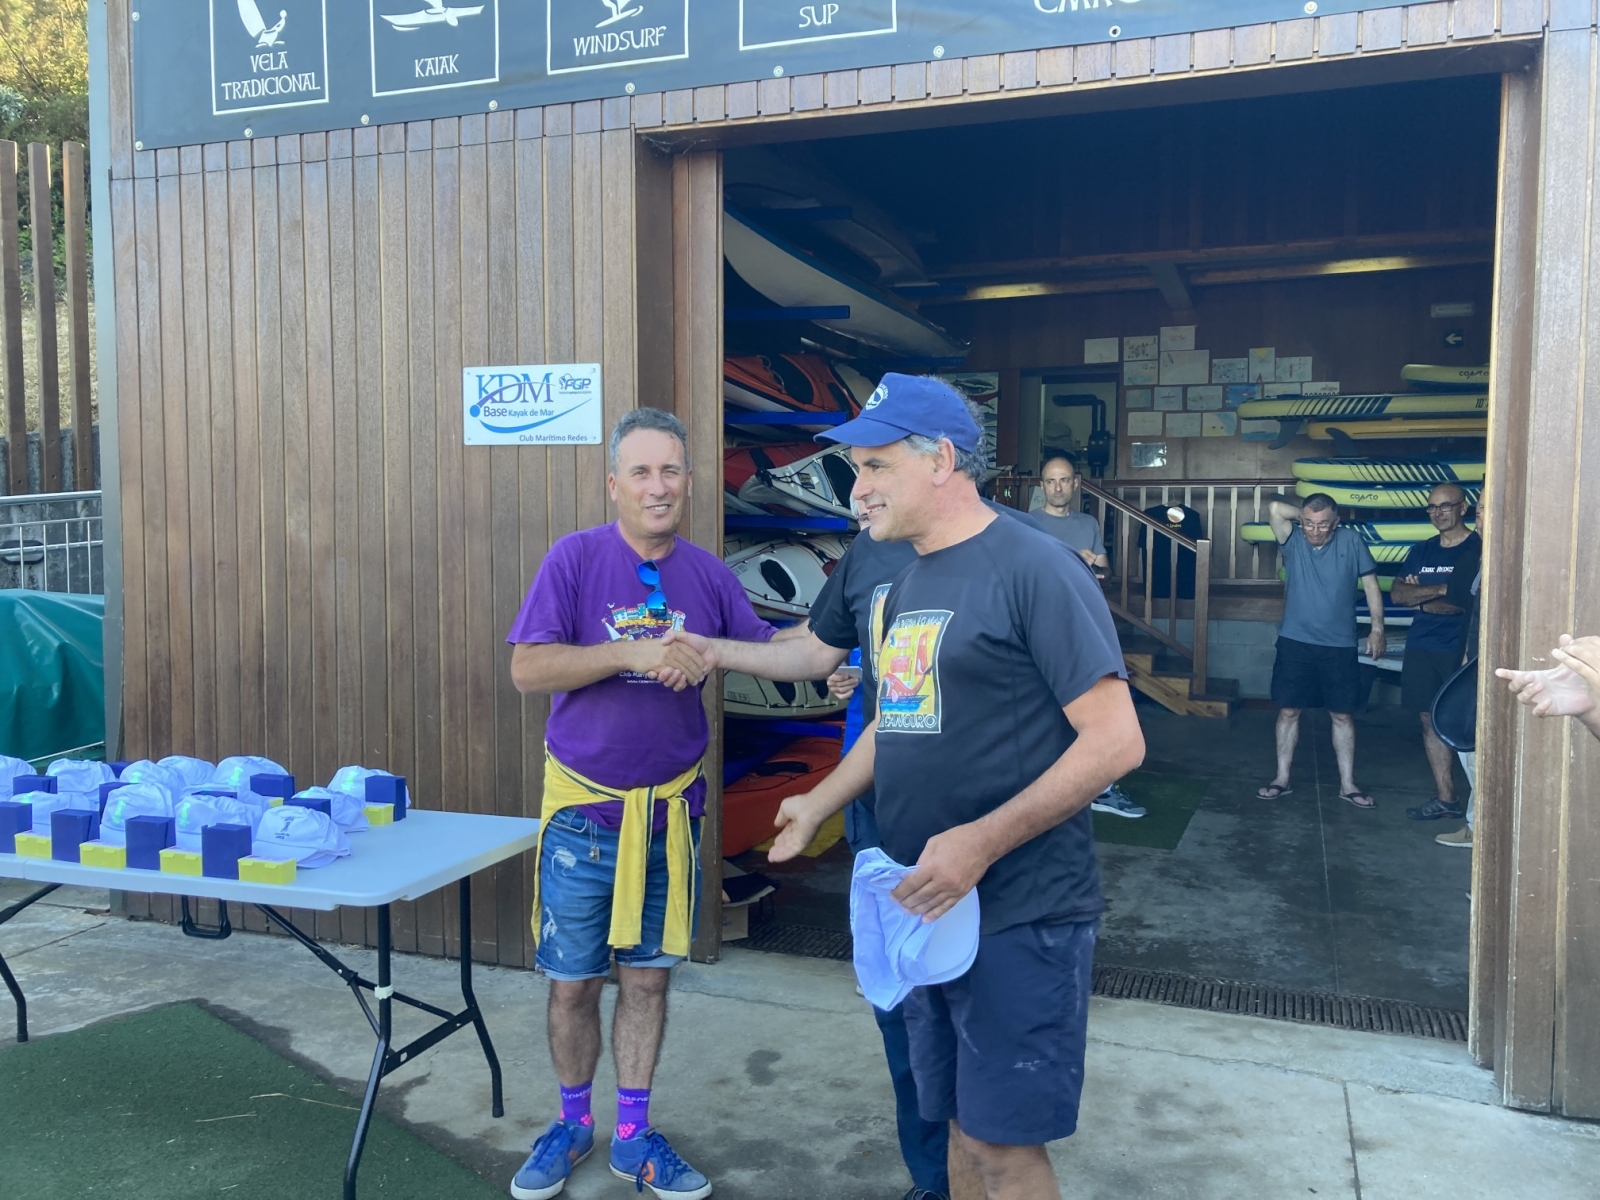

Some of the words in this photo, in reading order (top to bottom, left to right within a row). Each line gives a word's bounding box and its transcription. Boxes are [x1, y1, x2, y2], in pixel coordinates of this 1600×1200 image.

[798, 3, 839, 28] SUP
[573, 25, 667, 57] WINDSURF
[250, 51, 289, 73] VELA
[414, 53, 460, 78] KAIAK
[221, 71, 321, 101] TRADICIONAL
[475, 372, 555, 404] KDM
[564, 378, 592, 390] FGP
[483, 406, 508, 417] Base
[508, 409, 529, 418] Kayak
[529, 408, 539, 416] de
[539, 408, 555, 416] Mar
[519, 434, 534, 442] Club
[535, 434, 566, 442] Marítimo
